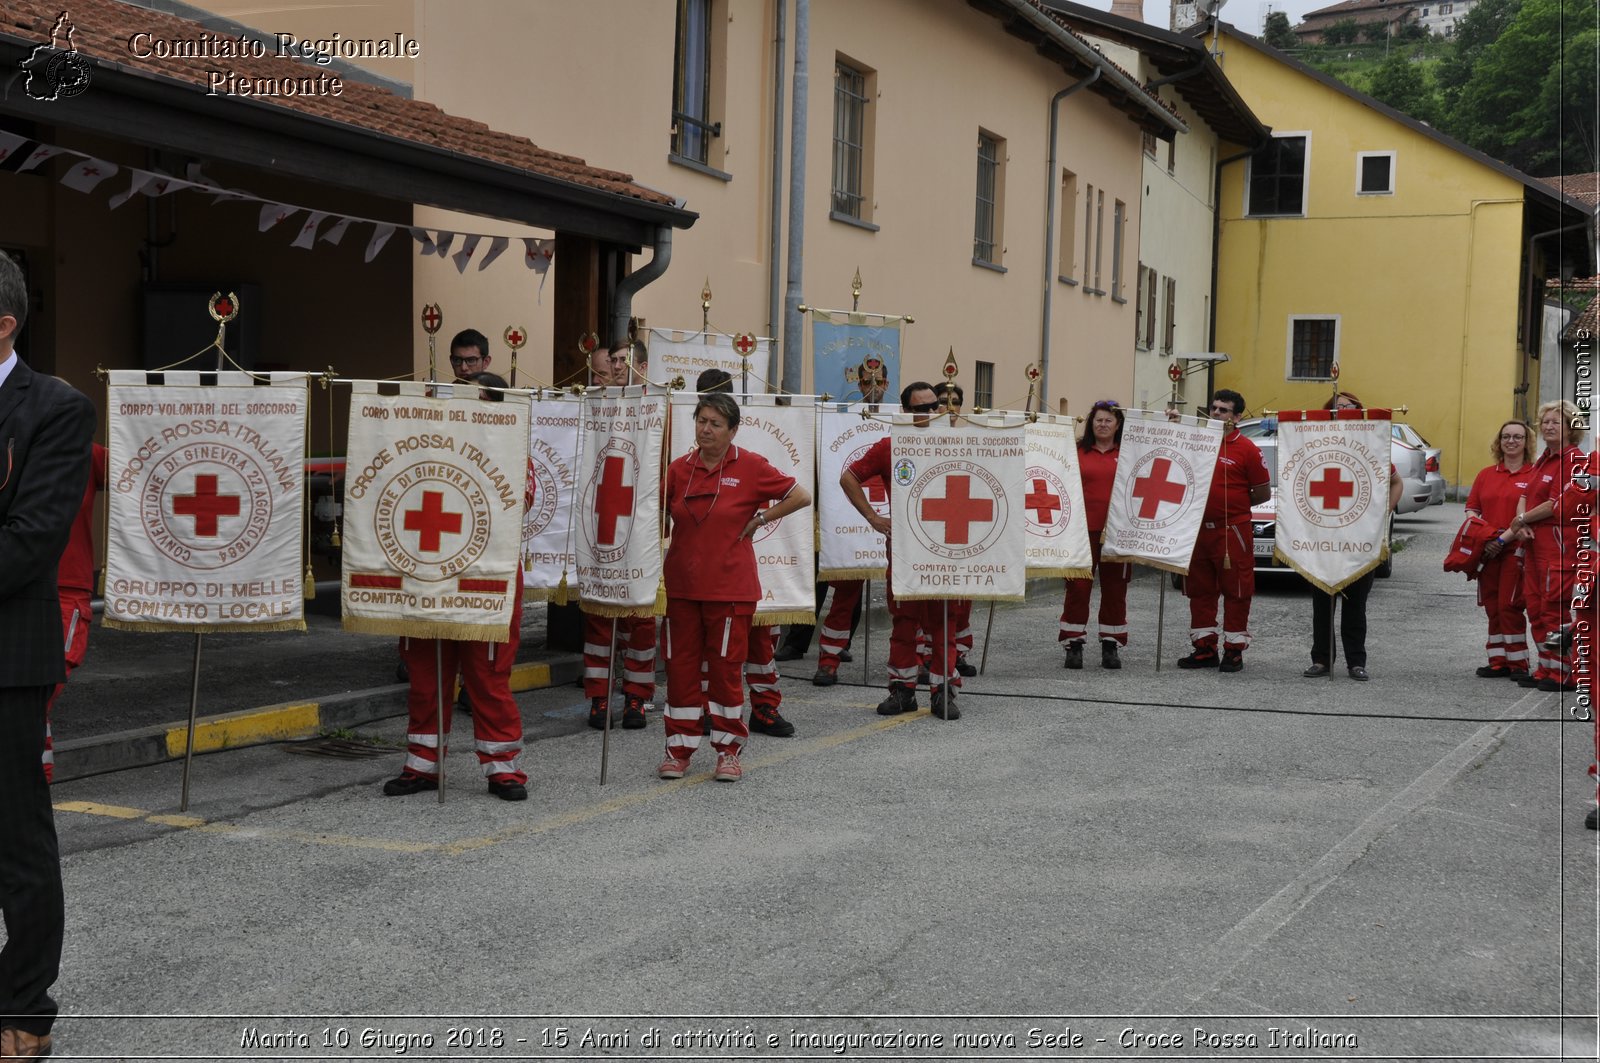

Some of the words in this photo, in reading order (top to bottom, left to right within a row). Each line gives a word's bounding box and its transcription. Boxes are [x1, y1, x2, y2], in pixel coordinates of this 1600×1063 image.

[662, 354, 689, 365] CROCE
[692, 357, 718, 368] ROSSA
[721, 360, 754, 372] ITALIAA
[120, 403, 154, 416] CORPO
[159, 403, 215, 416] VOLONTARI
[221, 403, 241, 415] DEL
[246, 403, 297, 415] SOCCORSO
[393, 407, 443, 421] VOLONTARI
[449, 410, 467, 422] DEL
[472, 412, 516, 426] SOCCORSO
[536, 416, 579, 427] SOCCORSO
[1329, 424, 1340, 432] DEL
[1344, 424, 1375, 432] SOCCORSO
[738, 416, 760, 428] SSA
[763, 420, 800, 467] ITALIANA
[830, 428, 855, 452] CROCE
[856, 422, 884, 434] ROSSA
[897, 436, 922, 444] CORPO
[924, 436, 963, 446] VOLONTARI
[966, 436, 980, 446] DEL
[983, 436, 1019, 447] SOCCORSO
[1123, 434, 1151, 444] CROCE
[1152, 437, 1178, 448] ROSSA
[1181, 442, 1217, 454] ITALIANA
[1176, 431, 1186, 440] DEL
[117, 437, 162, 494] CROCE
[161, 419, 230, 444] ROSSA
[234, 424, 296, 494] ITALIANA
[184, 446, 249, 471] GINEVRA
[893, 447, 930, 456] CROCE
[934, 447, 972, 456] ROSSA
[976, 447, 1024, 458] ITALIANA
[1043, 446, 1070, 472] ITALIANA
[1282, 448, 1306, 480] CROCE
[1305, 436, 1346, 452] ROSSA
[1349, 439, 1386, 484] ITALIANA
[1318, 453, 1357, 468] GINEVRA
[165, 456, 180, 474] DI
[533, 438, 572, 488] ITALIANA
[534, 464, 548, 477] 22
[1306, 461, 1316, 470] DI
[247, 470, 264, 490] 22
[350, 449, 394, 500] CROCE
[395, 434, 455, 455] ROSSA
[460, 441, 517, 511] ITALIANA
[397, 473, 412, 489] DI
[415, 465, 472, 491] GINEVRA
[911, 462, 962, 500] CONVENZIONE
[966, 463, 974, 472] DI
[977, 468, 1004, 500] GINEVRA
[1052, 475, 1060, 486] 22
[1356, 468, 1366, 478] 22
[470, 491, 484, 507] 22
[540, 479, 556, 521] AGOSTO
[1296, 470, 1322, 524] CONVENZIONE
[145, 476, 191, 562] CONVENZIONE
[248, 490, 268, 539] AGOSTO
[377, 489, 416, 573] CONVENZIONE
[466, 510, 488, 556] AGOSTO
[835, 526, 875, 534] COMITAT
[1116, 540, 1170, 555] PEVERAGNO
[1169, 537, 1178, 546] DI
[1291, 539, 1372, 553] SAVIGLIANO
[757, 556, 798, 566] OCALE
[855, 550, 885, 560] DRON
[1025, 548, 1069, 558] CENTALLO
[440, 554, 469, 576] 1864
[632, 568, 644, 578] DI
[912, 563, 958, 573] COMITATO
[968, 565, 1006, 573] LOCALE
[113, 579, 198, 597] GRUPPO
[206, 582, 223, 598] DI
[232, 578, 295, 598] MELLE
[920, 574, 994, 586] MORETTA
[349, 591, 417, 608] COMITATO
[421, 597, 436, 609] DI
[579, 583, 630, 599] RACCONIGI
[113, 599, 208, 618] COMITATO
[218, 600, 292, 619] LOCALE
